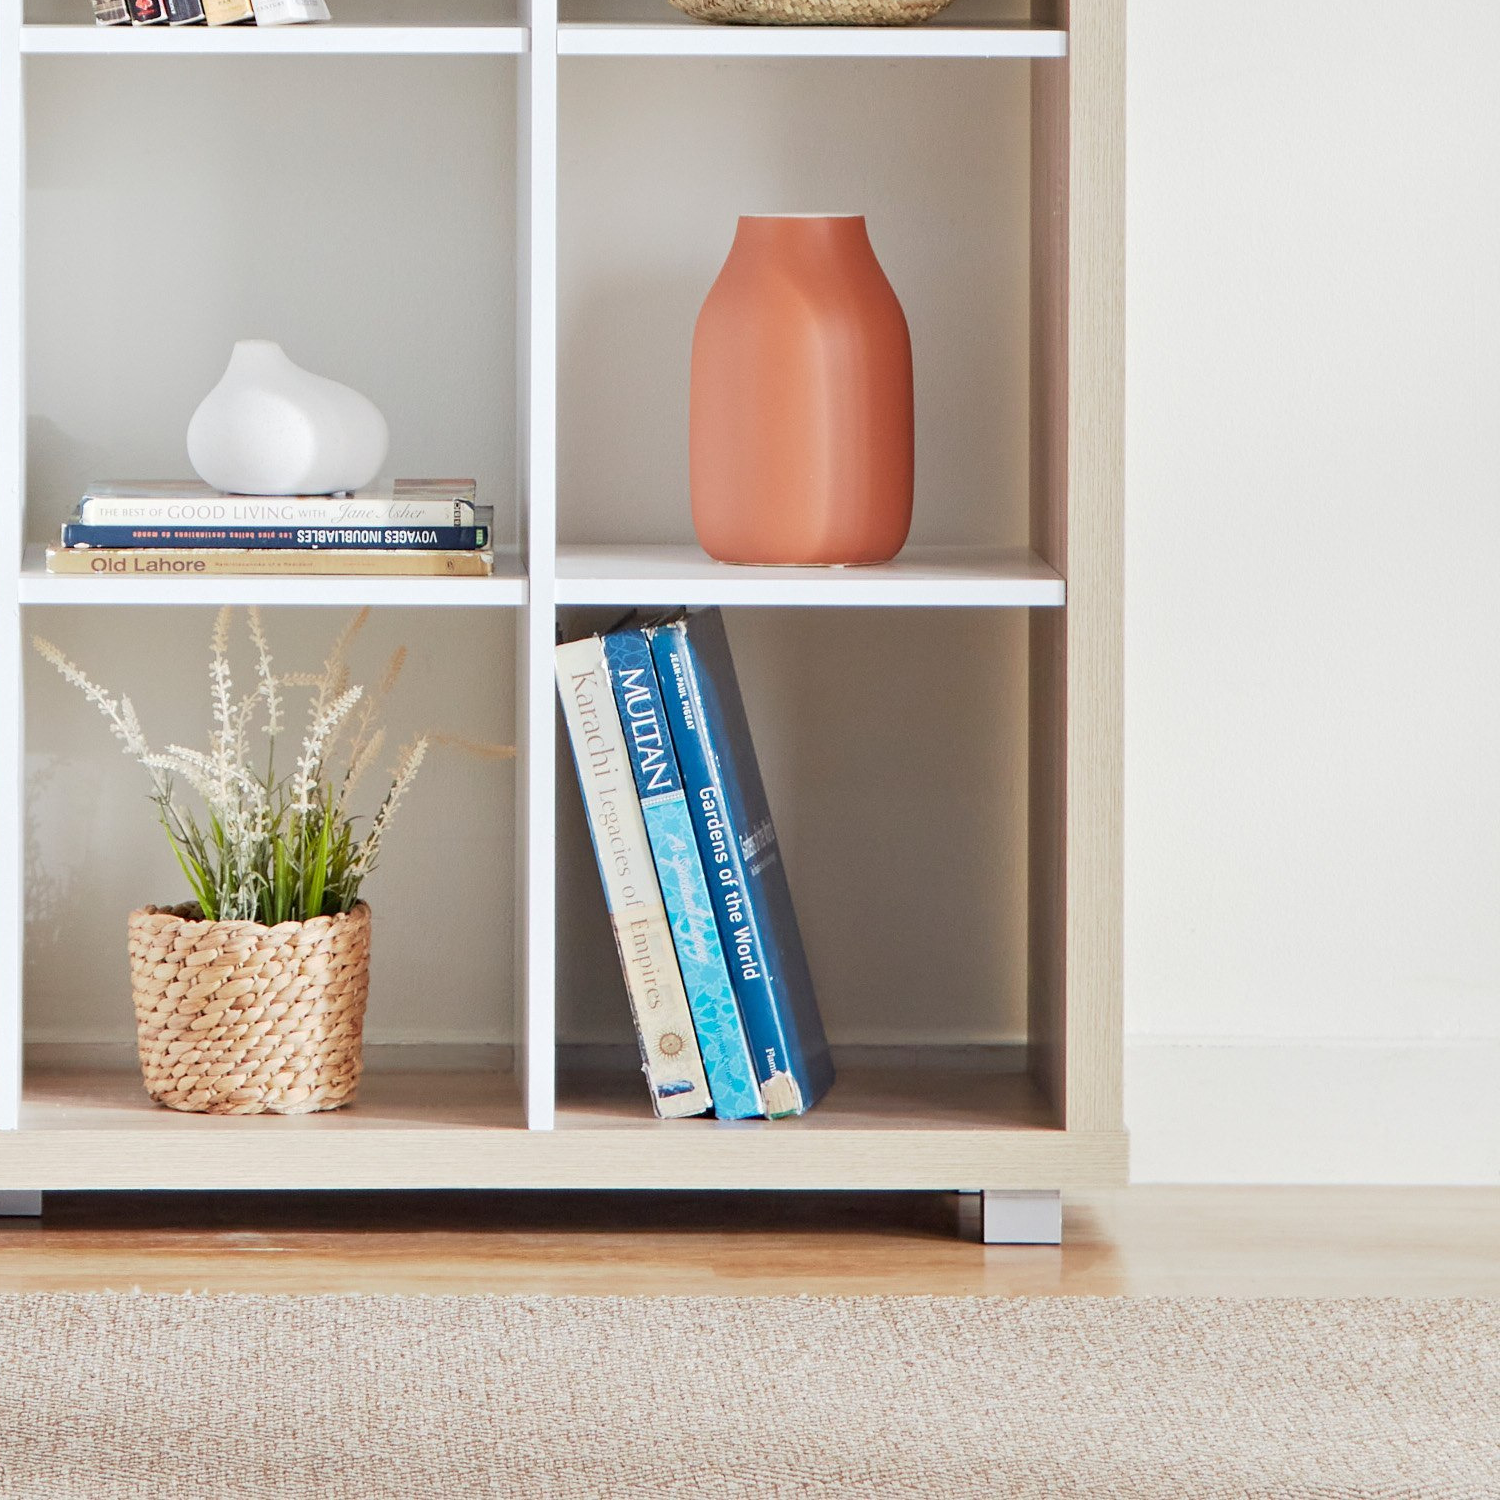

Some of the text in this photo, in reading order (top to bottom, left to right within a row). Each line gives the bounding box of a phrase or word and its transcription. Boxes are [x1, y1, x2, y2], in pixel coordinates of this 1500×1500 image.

[100, 508, 118, 517] THE
[122, 508, 145, 517] BEST
[149, 508, 163, 517] OF
[167, 505, 226, 520] GOOD
[233, 505, 294, 520] LIVING
[298, 508, 326, 518] WITH
[331, 503, 373, 523] Jane
[297, 529, 438, 543] VOYAGES INOUBLIABLES
[91, 558, 206, 572] Old Lahore
[618, 664, 672, 790] MULTAN
[668, 651, 695, 730] JEAN-PAUL PIGEAT
[570, 669, 667, 1011] Karachi Legacies of Empires
[697, 784, 761, 981] Gardens of the World
